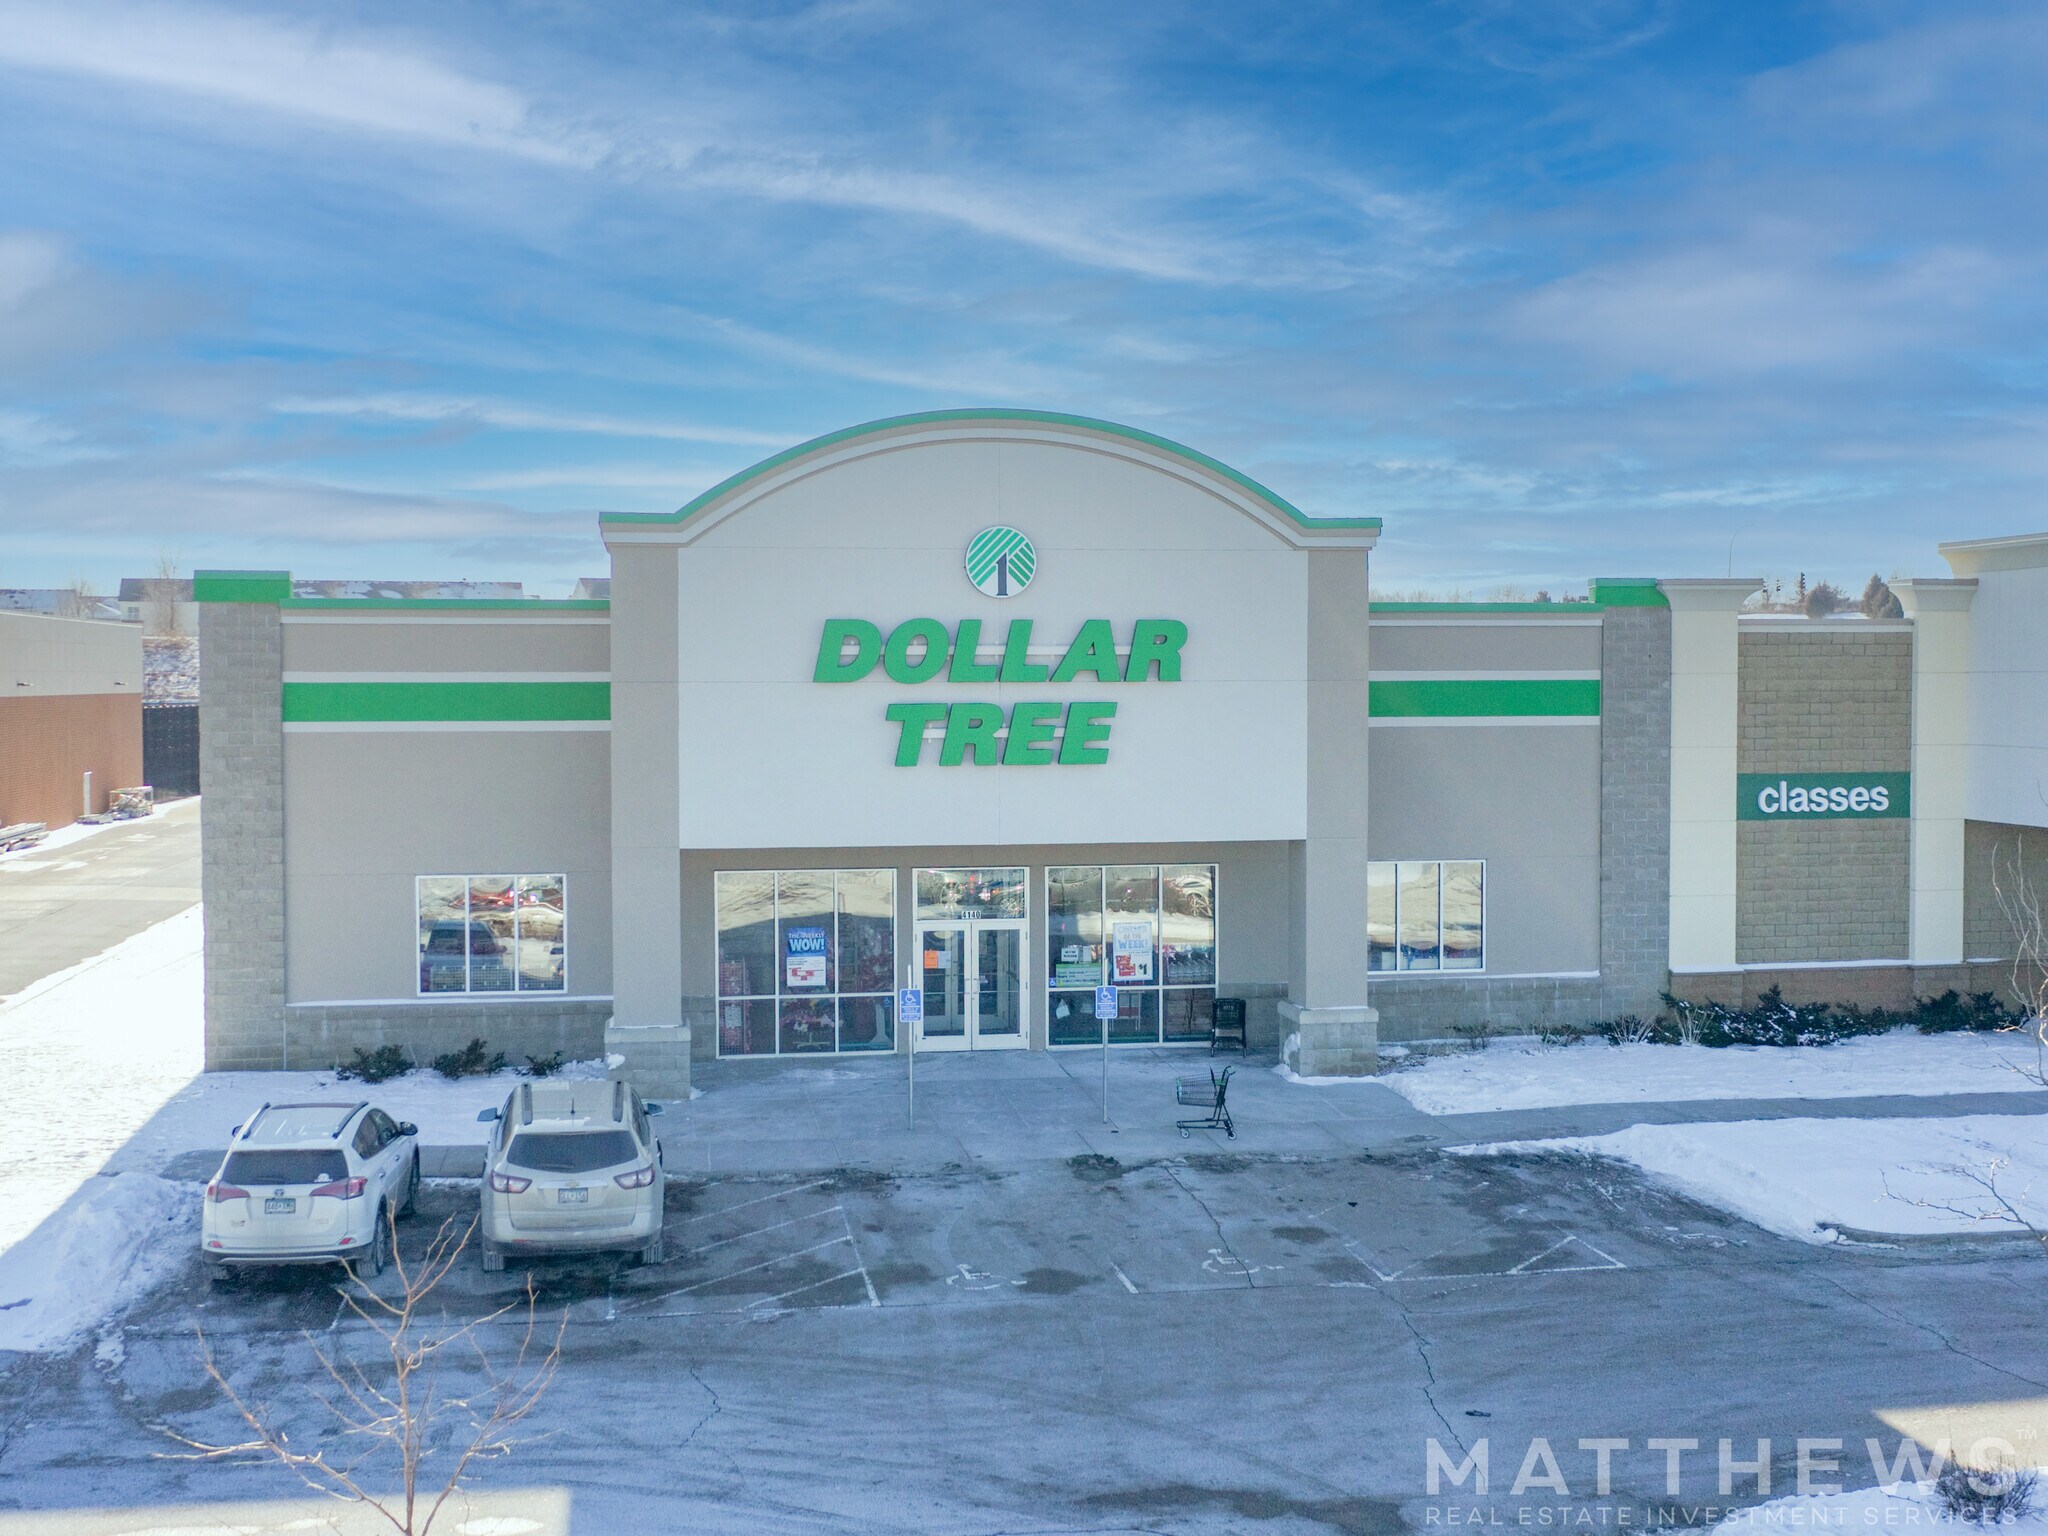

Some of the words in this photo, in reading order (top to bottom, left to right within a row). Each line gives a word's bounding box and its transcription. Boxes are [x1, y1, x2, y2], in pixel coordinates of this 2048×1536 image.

[813, 618, 1188, 684] DOLLAR
[885, 702, 1118, 767] TREE
[1757, 780, 1890, 814] classes
[961, 909, 981, 919] 4140
[789, 939, 825, 951] WOW!
